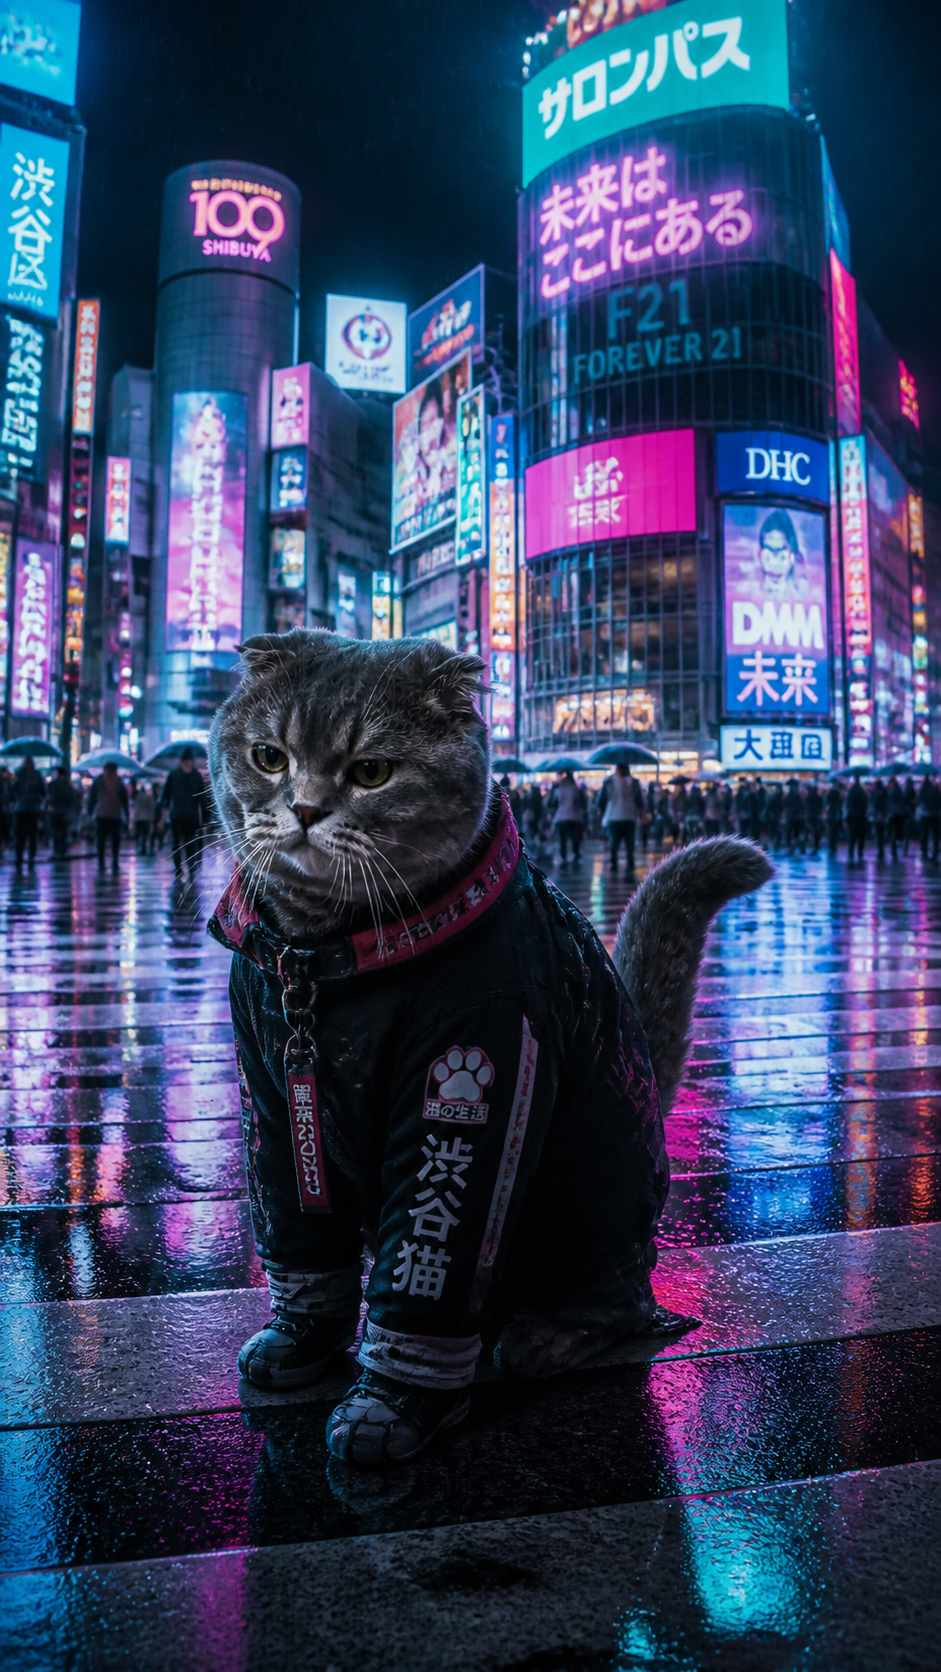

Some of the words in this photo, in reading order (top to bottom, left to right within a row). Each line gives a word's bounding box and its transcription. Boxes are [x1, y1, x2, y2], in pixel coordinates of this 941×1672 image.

[538, 16, 750, 140] サロンパス
[189, 190, 285, 257] 109
[539, 146, 667, 245] 未来は
[202, 239, 271, 262] SHIBUYA
[540, 189, 753, 299] ここにある
[607, 279, 690, 340] F21
[573, 331, 703, 384] FOREVER
[711, 326, 741, 360] 21
[745, 447, 811, 486] DHC
[731, 600, 824, 650] DMM
[736, 651, 819, 707] 未来
[392, 1133, 473, 1301] 渋谷猫
